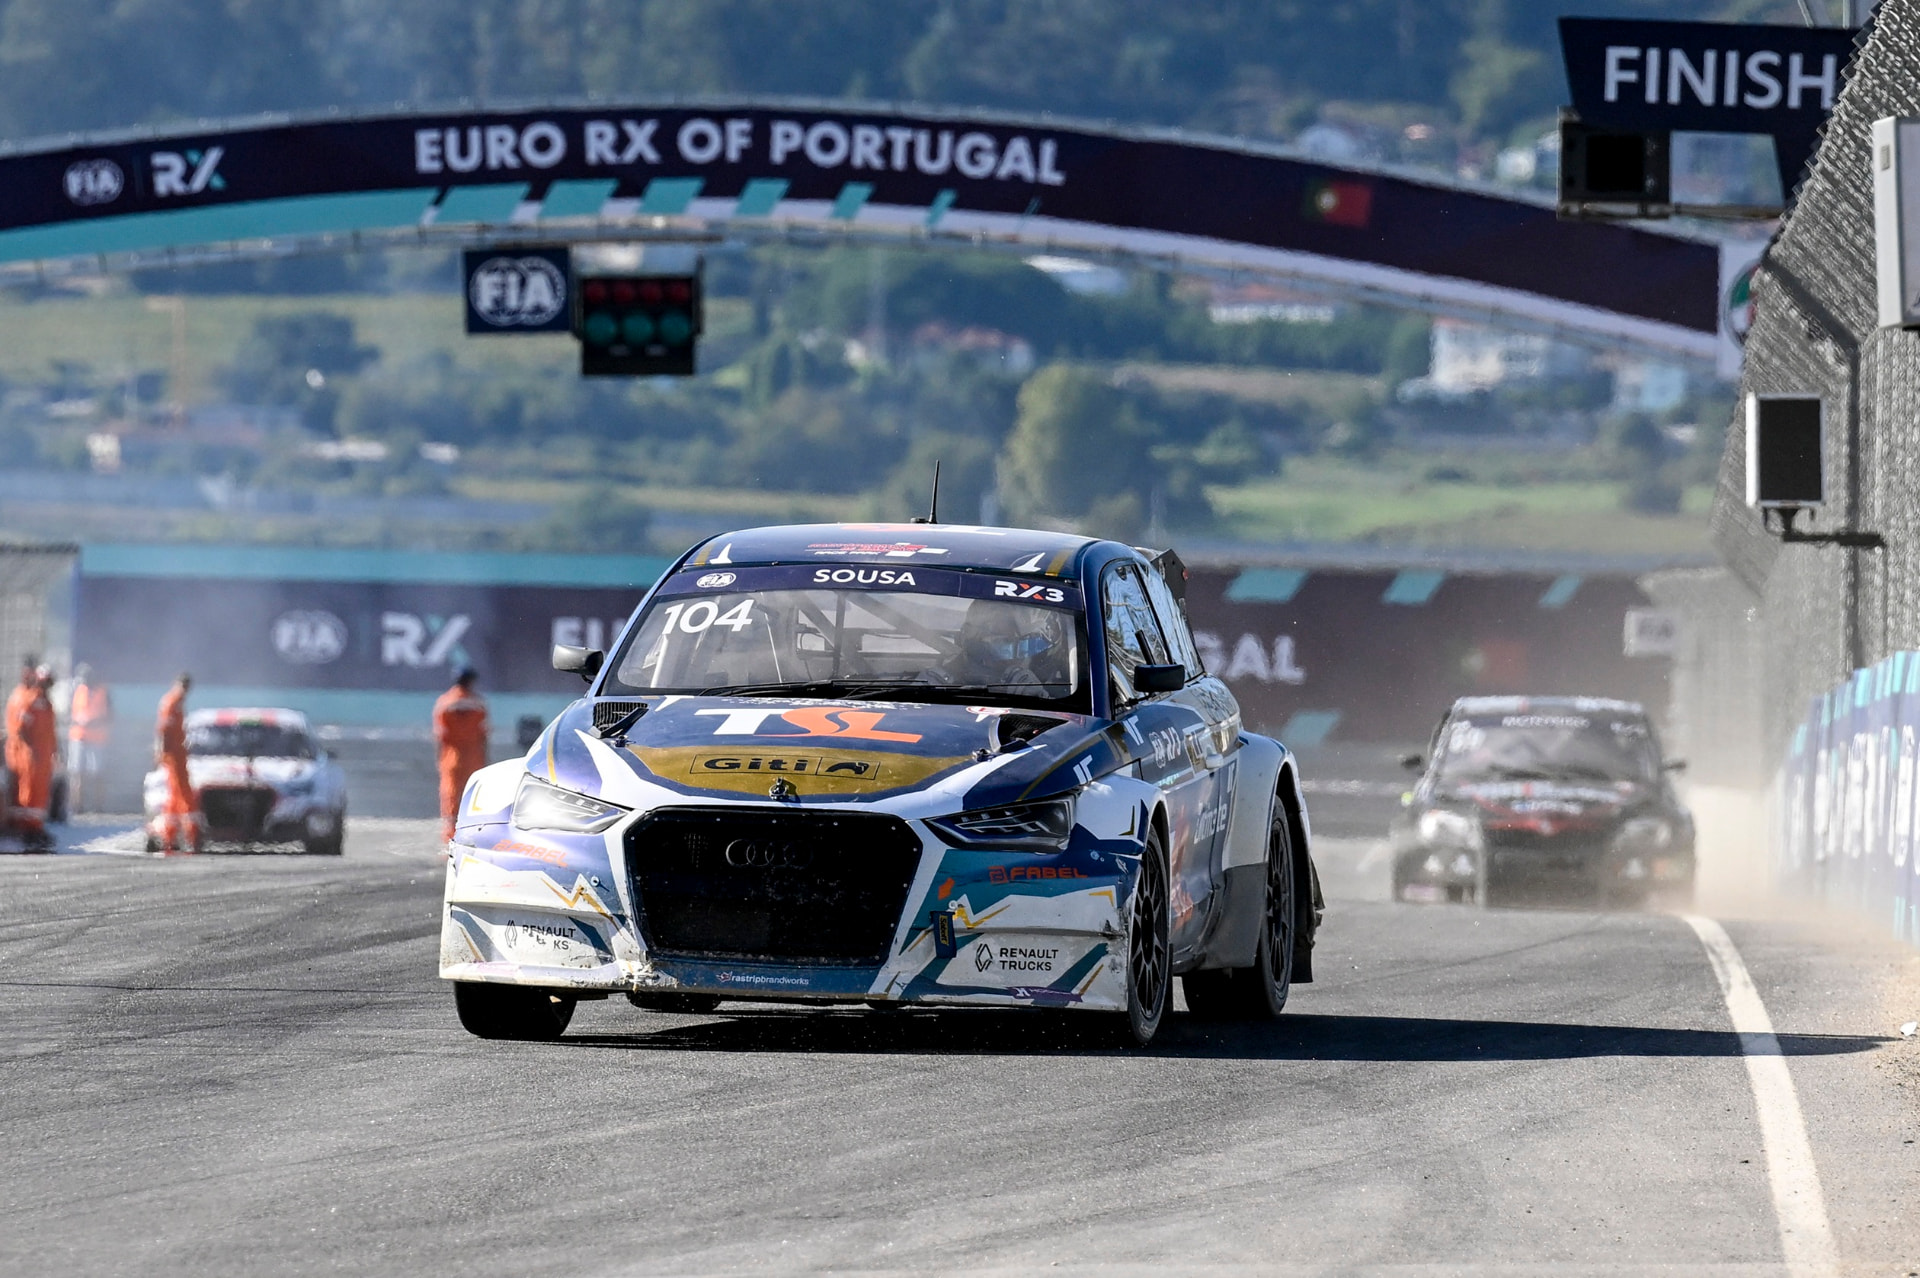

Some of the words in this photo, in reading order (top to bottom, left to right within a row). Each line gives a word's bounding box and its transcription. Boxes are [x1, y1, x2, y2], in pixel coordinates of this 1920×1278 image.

[1603, 45, 1838, 111] FINISH
[414, 121, 567, 175] EURO
[584, 118, 662, 167] RX
[676, 118, 753, 164] OF
[769, 120, 1067, 187] PORTUGAL
[151, 146, 227, 198] RX
[813, 568, 917, 587] SOUSA
[994, 579, 1065, 603] RX3
[661, 599, 755, 635] 104
[381, 611, 471, 667] RX
[703, 757, 809, 772] Giti
[1010, 866, 1089, 879] FABEL
[999, 947, 1059, 959] RENAULT
[999, 960, 1052, 971] TRUCKS
